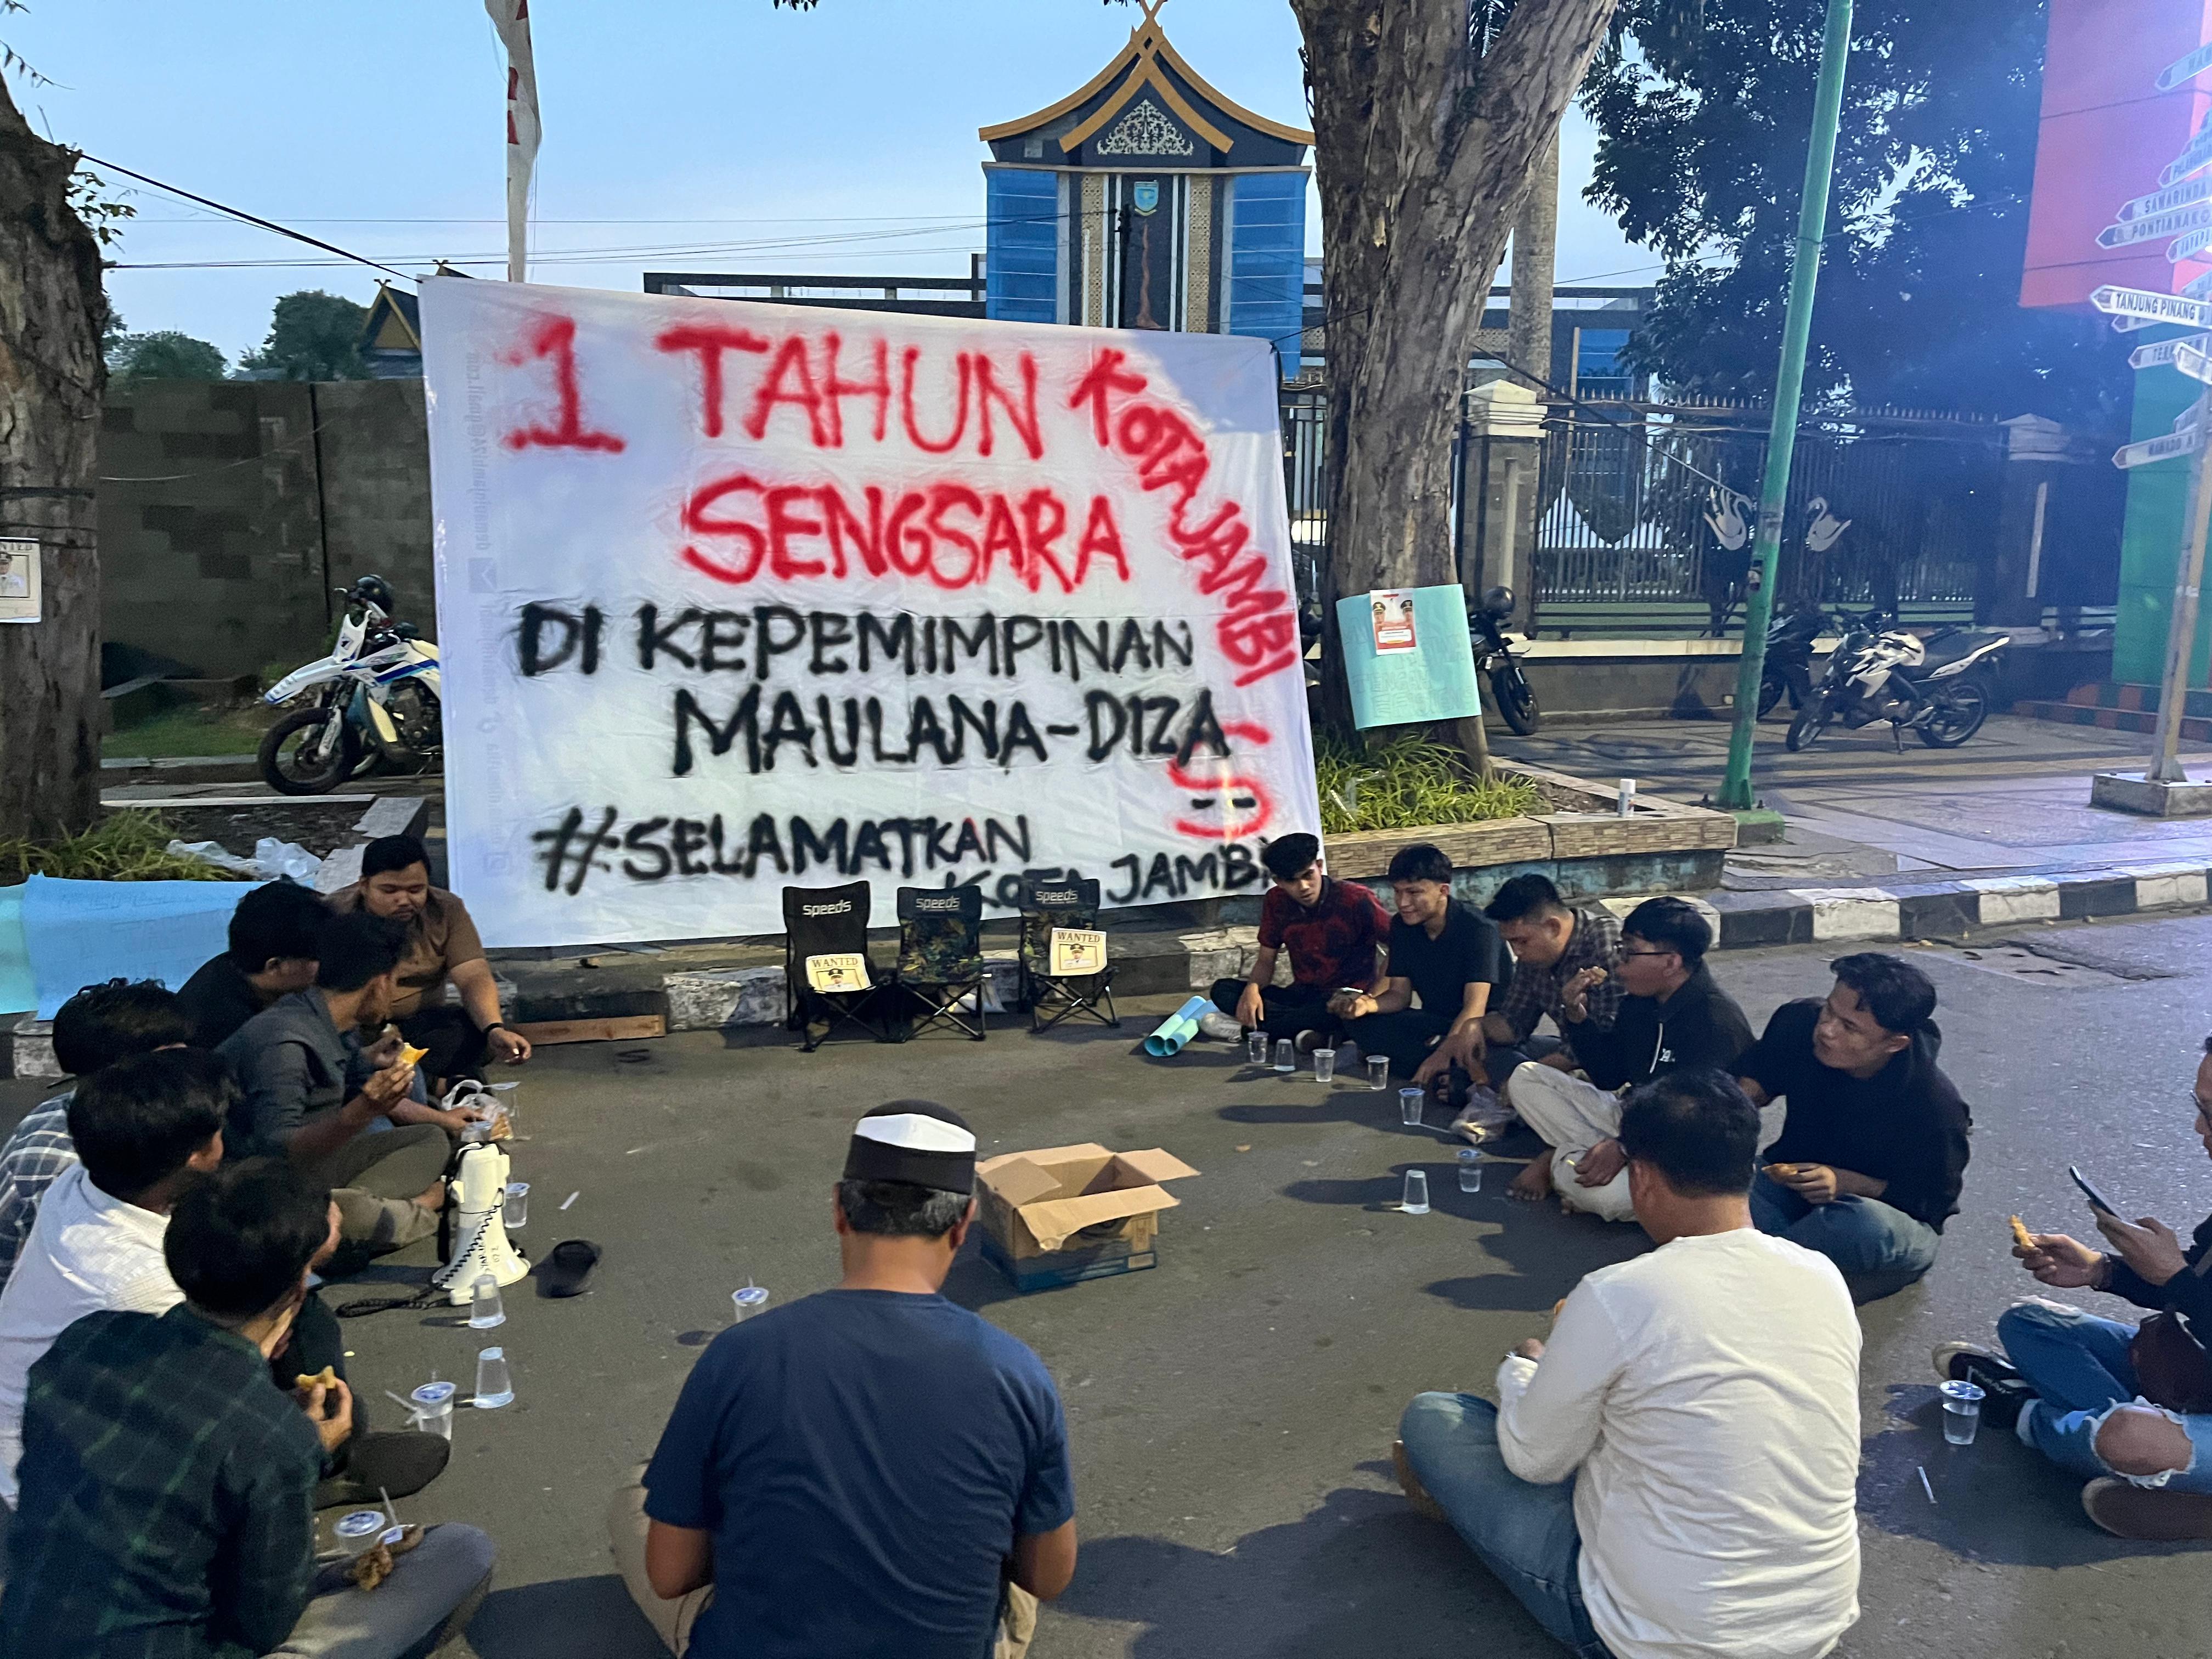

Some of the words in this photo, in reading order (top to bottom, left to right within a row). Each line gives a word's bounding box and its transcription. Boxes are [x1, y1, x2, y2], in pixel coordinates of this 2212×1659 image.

[2117, 293, 2158, 314] TANJUNG
[2160, 298, 2196, 320] PINANG
[499, 314, 627, 453] 1
[656, 323, 1045, 462] TAHUN
[682, 473, 1130, 593] SENGSARA
[1069, 347, 1209, 497] KOTA
[1170, 496, 1298, 688] JAMBI
[518, 602, 605, 677] DI
[635, 603, 1194, 682] KEPEMIMPINAN
[673, 684, 1231, 776] MAULANA-DIZA
[532, 806, 1031, 896] #SELAMATKAN
[945, 867, 1084, 909] KO
[811, 957, 859, 968] WANTED
[1057, 931, 1101, 943] WANTED
